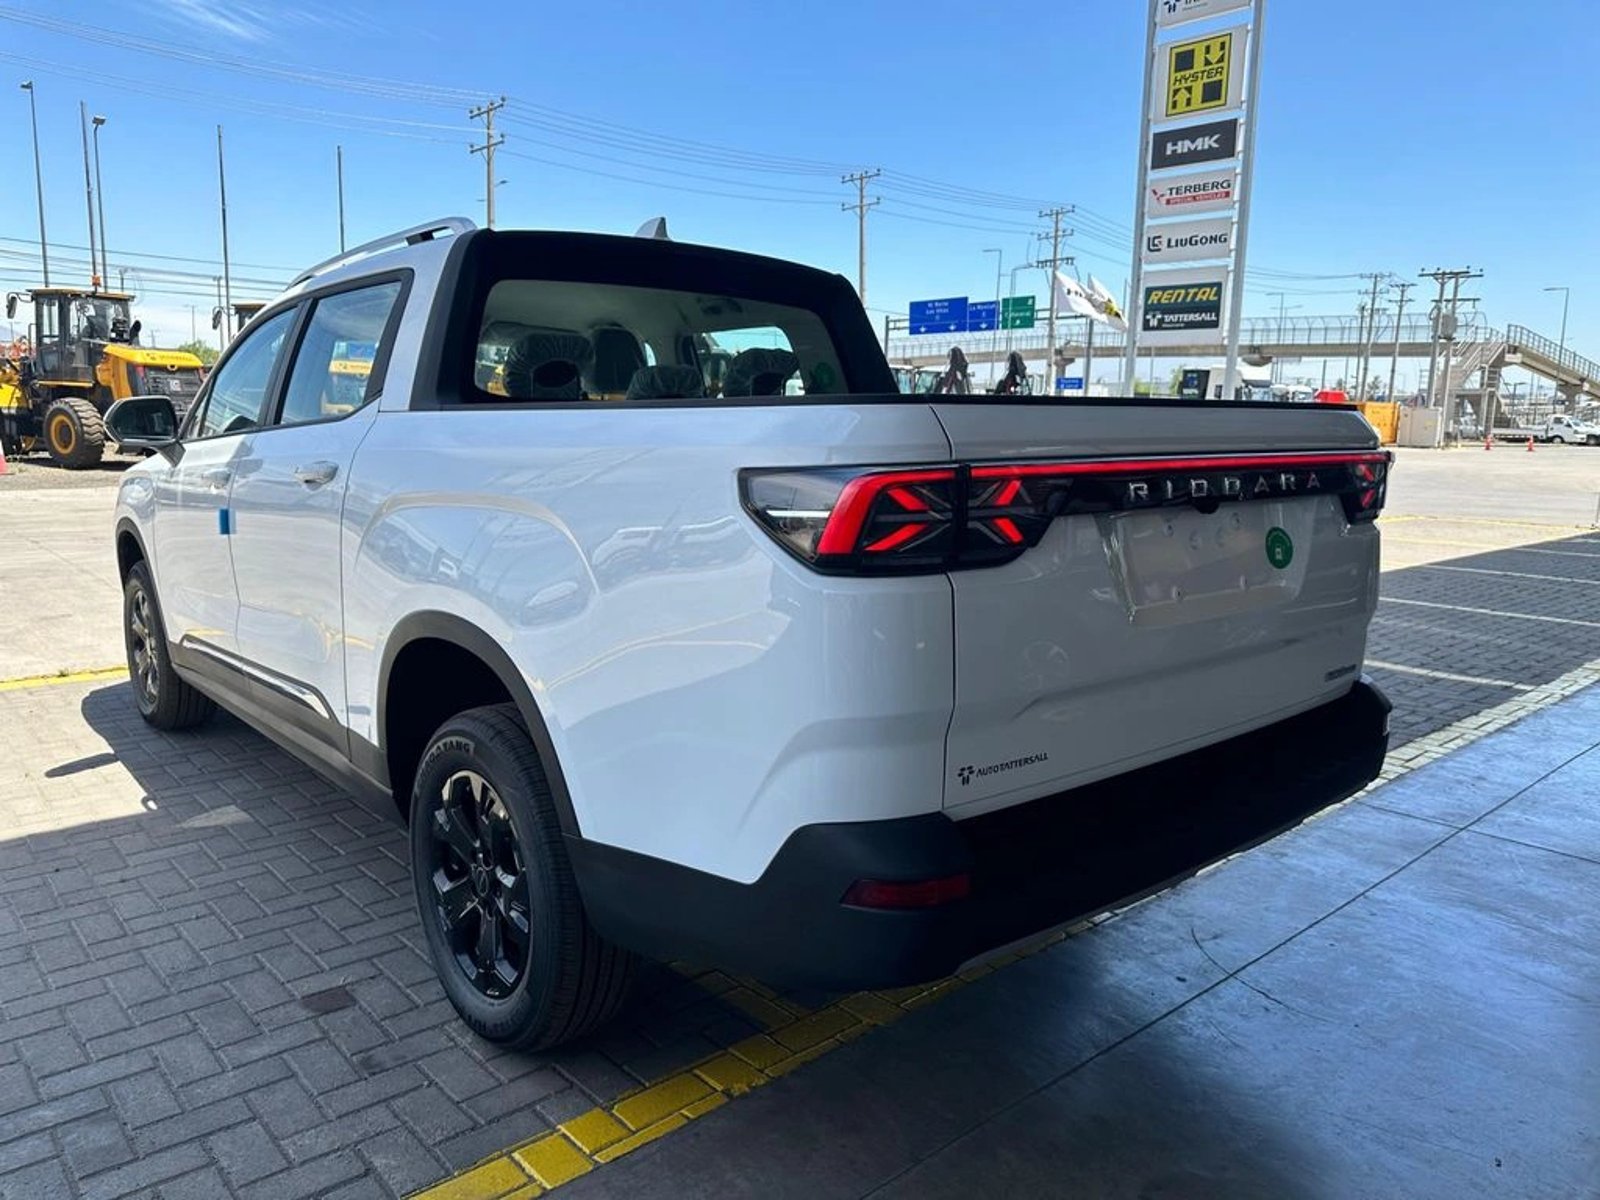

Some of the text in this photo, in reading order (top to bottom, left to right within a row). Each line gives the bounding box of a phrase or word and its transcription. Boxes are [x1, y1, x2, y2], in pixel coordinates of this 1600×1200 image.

[1173, 66, 1224, 85] HYSTER
[1165, 134, 1221, 154] HMK
[1168, 179, 1232, 196] TERBERG
[1148, 287, 1218, 304] RENTAL
[1163, 312, 1218, 323] TATTERSALL
[1128, 472, 1321, 499] RIDDARA
